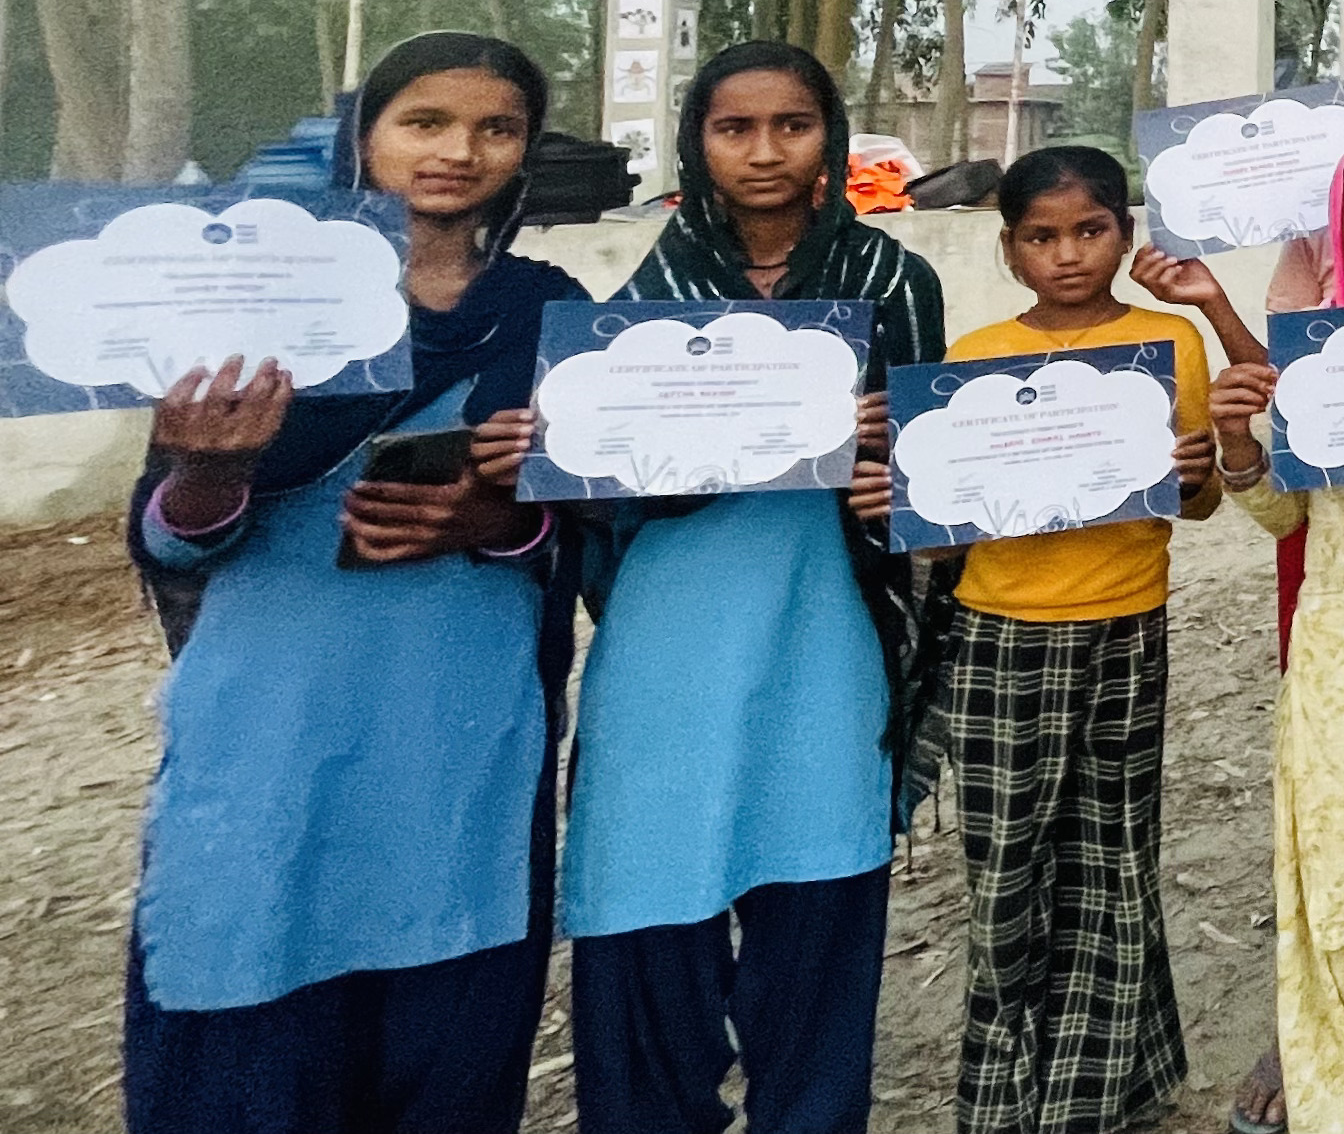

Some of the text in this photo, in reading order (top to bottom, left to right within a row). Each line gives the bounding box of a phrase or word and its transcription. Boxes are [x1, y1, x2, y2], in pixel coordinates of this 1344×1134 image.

[951, 403, 1120, 428] CERTIFICATE OF PARTICIPATION
